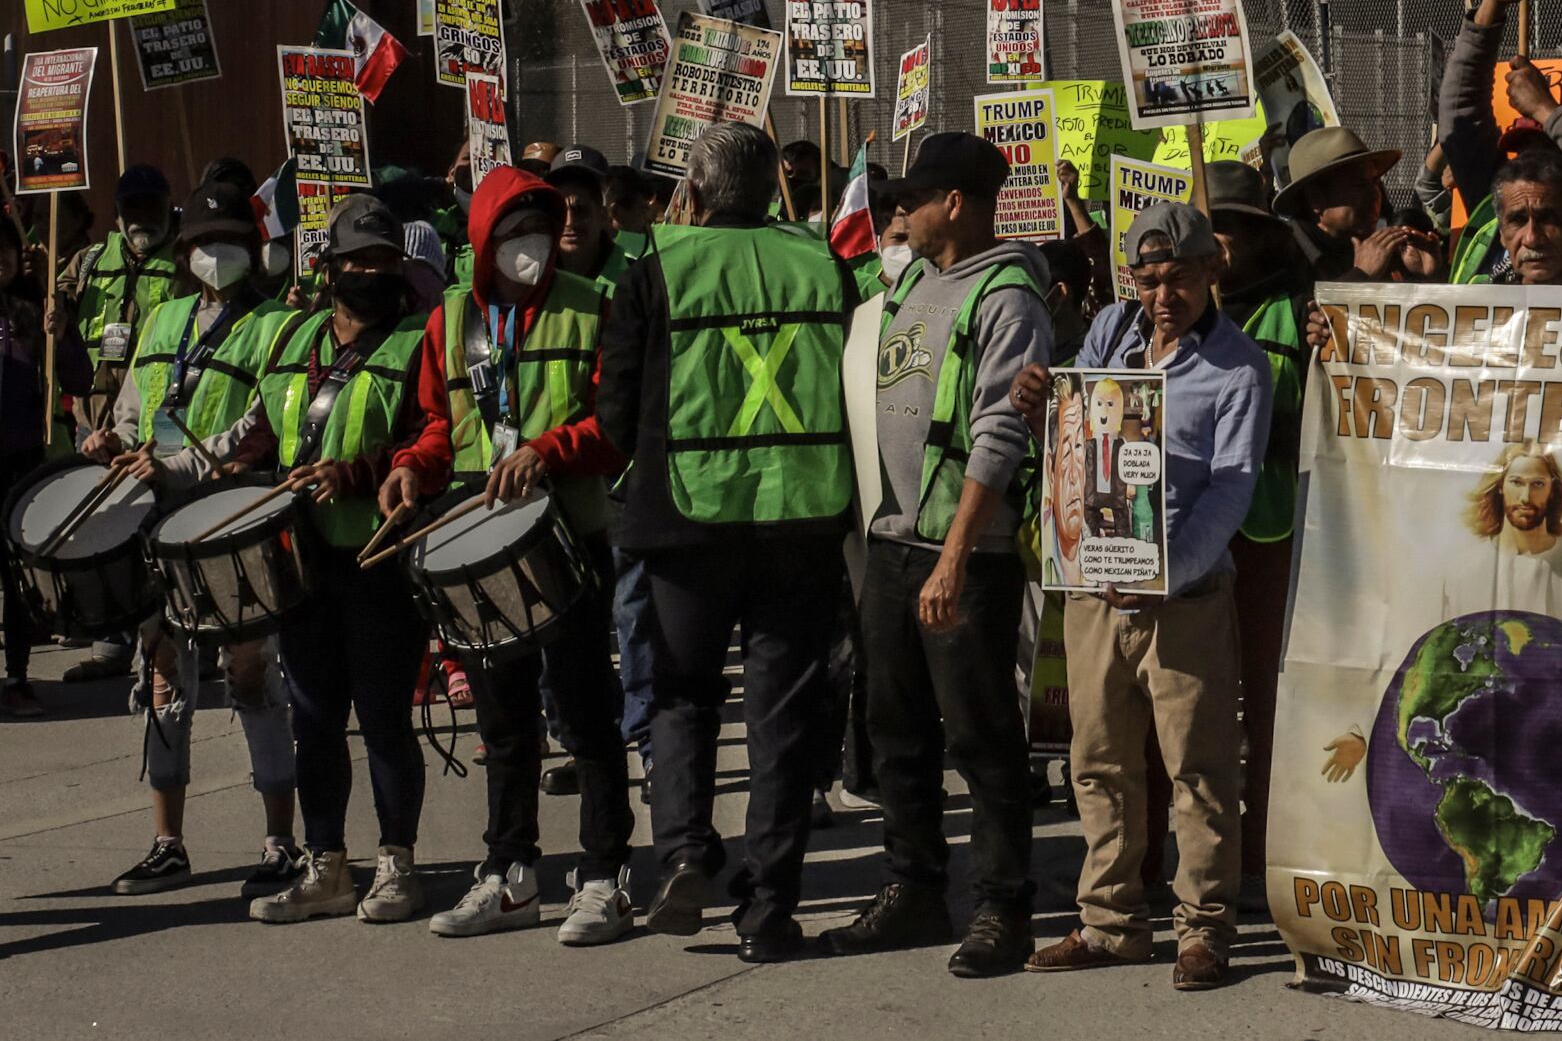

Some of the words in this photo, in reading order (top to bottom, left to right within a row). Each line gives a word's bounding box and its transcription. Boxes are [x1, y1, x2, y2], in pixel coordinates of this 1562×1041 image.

[792, 2, 809, 18] EL
[813, 3, 861, 19] PATIO
[791, 24, 863, 40] TRASERO
[1007, 21, 1020, 30] DE
[440, 27, 500, 53] GRINGOS
[993, 32, 1036, 41] ESTADOS
[757, 39, 769, 49] 174
[817, 45, 835, 57] DE
[996, 42, 1033, 52] UNIDOS
[1141, 47, 1158, 55] QUE
[1177, 41, 1227, 51] DEVUELVAN
[463, 47, 480, 64] GO
[1008, 54, 1020, 62] EN
[1147, 55, 1166, 67] LO
[1170, 49, 1224, 65] ROBADO
[48, 62, 84, 75] MIGRANTE
[797, 59, 862, 80] EE.UU.
[989, 63, 1041, 74] MEXICO
[674, 63, 700, 79] ROBO
[702, 70, 716, 83] DE
[717, 72, 762, 93] NUESTRO
[28, 85, 69, 98] REAPERTURA
[301, 80, 359, 95] QUEREMOS
[672, 78, 759, 107] TERRITORIO
[286, 93, 320, 107] SEGUIR
[324, 97, 360, 109] SIENDO
[292, 109, 312, 122] EL
[315, 110, 356, 125] PATIO
[983, 100, 1044, 121] TRUMP
[292, 125, 359, 143] TRASERO
[984, 122, 1046, 143] MEXICO
[320, 143, 334, 153] DE
[1061, 143, 1128, 157] AMOR
[296, 155, 360, 173] EE.UU.
[1014, 165, 1036, 176] MURO
[1038, 164, 1048, 174] EN
[1034, 175, 1049, 185] SUR
[1120, 167, 1186, 195] TRUMP
[1017, 198, 1055, 210] HERMANOS
[1001, 223, 1017, 234] PASO
[1018, 221, 1037, 232] HACIA
[741, 317, 777, 329] JYRSA
[1124, 449, 1132, 457] JA
[1134, 449, 1142, 457] JA
[1143, 449, 1151, 457] JA
[1123, 471, 1139, 479] VERY
[1140, 471, 1156, 479] MUCH
[1084, 544, 1103, 552] VERAS
[1105, 544, 1134, 553] GÜERITO
[1114, 557, 1154, 565] TRUMPEAMOS
[1084, 567, 1103, 575] COMO
[1104, 567, 1132, 575] MEXICAN
[1294, 877, 1379, 927] POR
[1391, 888, 1487, 937] UNA
[1331, 926, 1401, 975] SIN
[1317, 957, 1345, 977] LOS
[1347, 965, 1452, 1003] DESCENDIENTES
[1524, 988, 1550, 1007] DE
